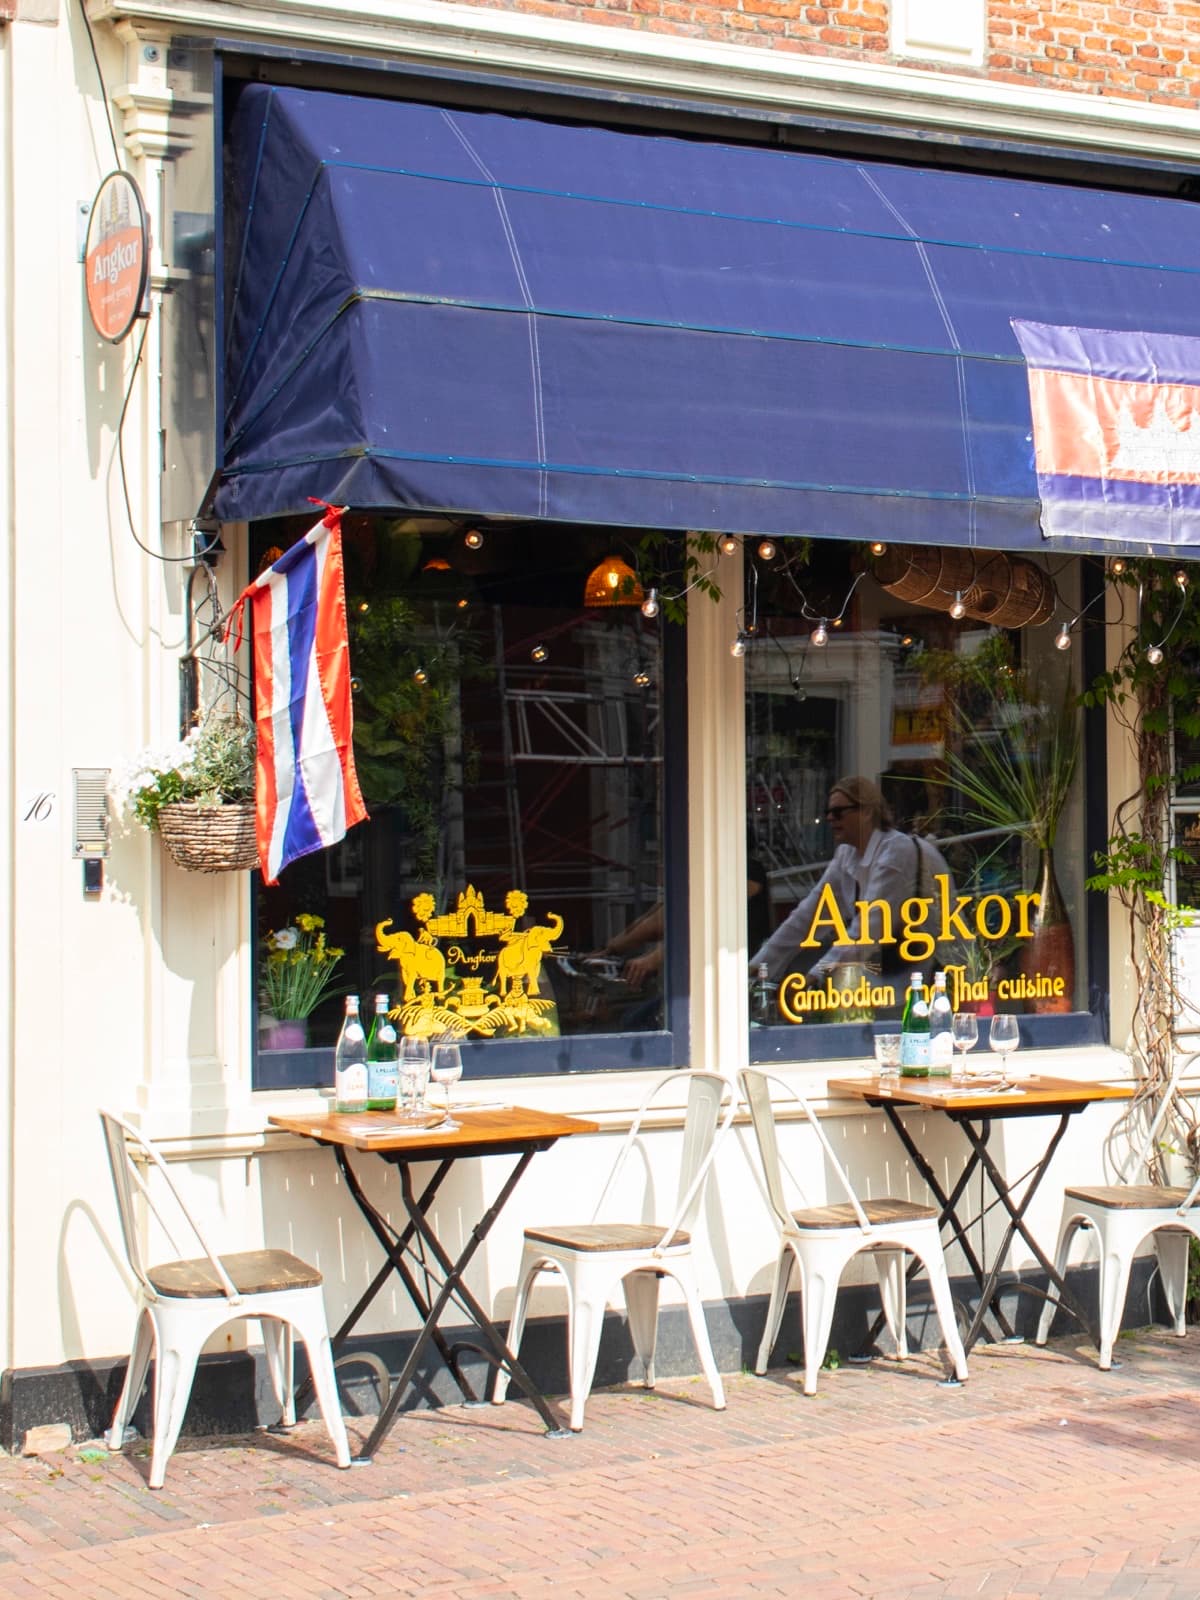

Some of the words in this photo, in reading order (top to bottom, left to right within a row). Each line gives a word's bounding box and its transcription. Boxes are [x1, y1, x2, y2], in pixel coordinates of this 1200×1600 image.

[94, 242, 138, 283] Angkor
[23, 792, 56, 822] 16
[799, 873, 1041, 962] Angkor
[779, 972, 896, 1023] Cambodian
[943, 964, 989, 1012] Thai
[998, 972, 1065, 1000] cuisine
